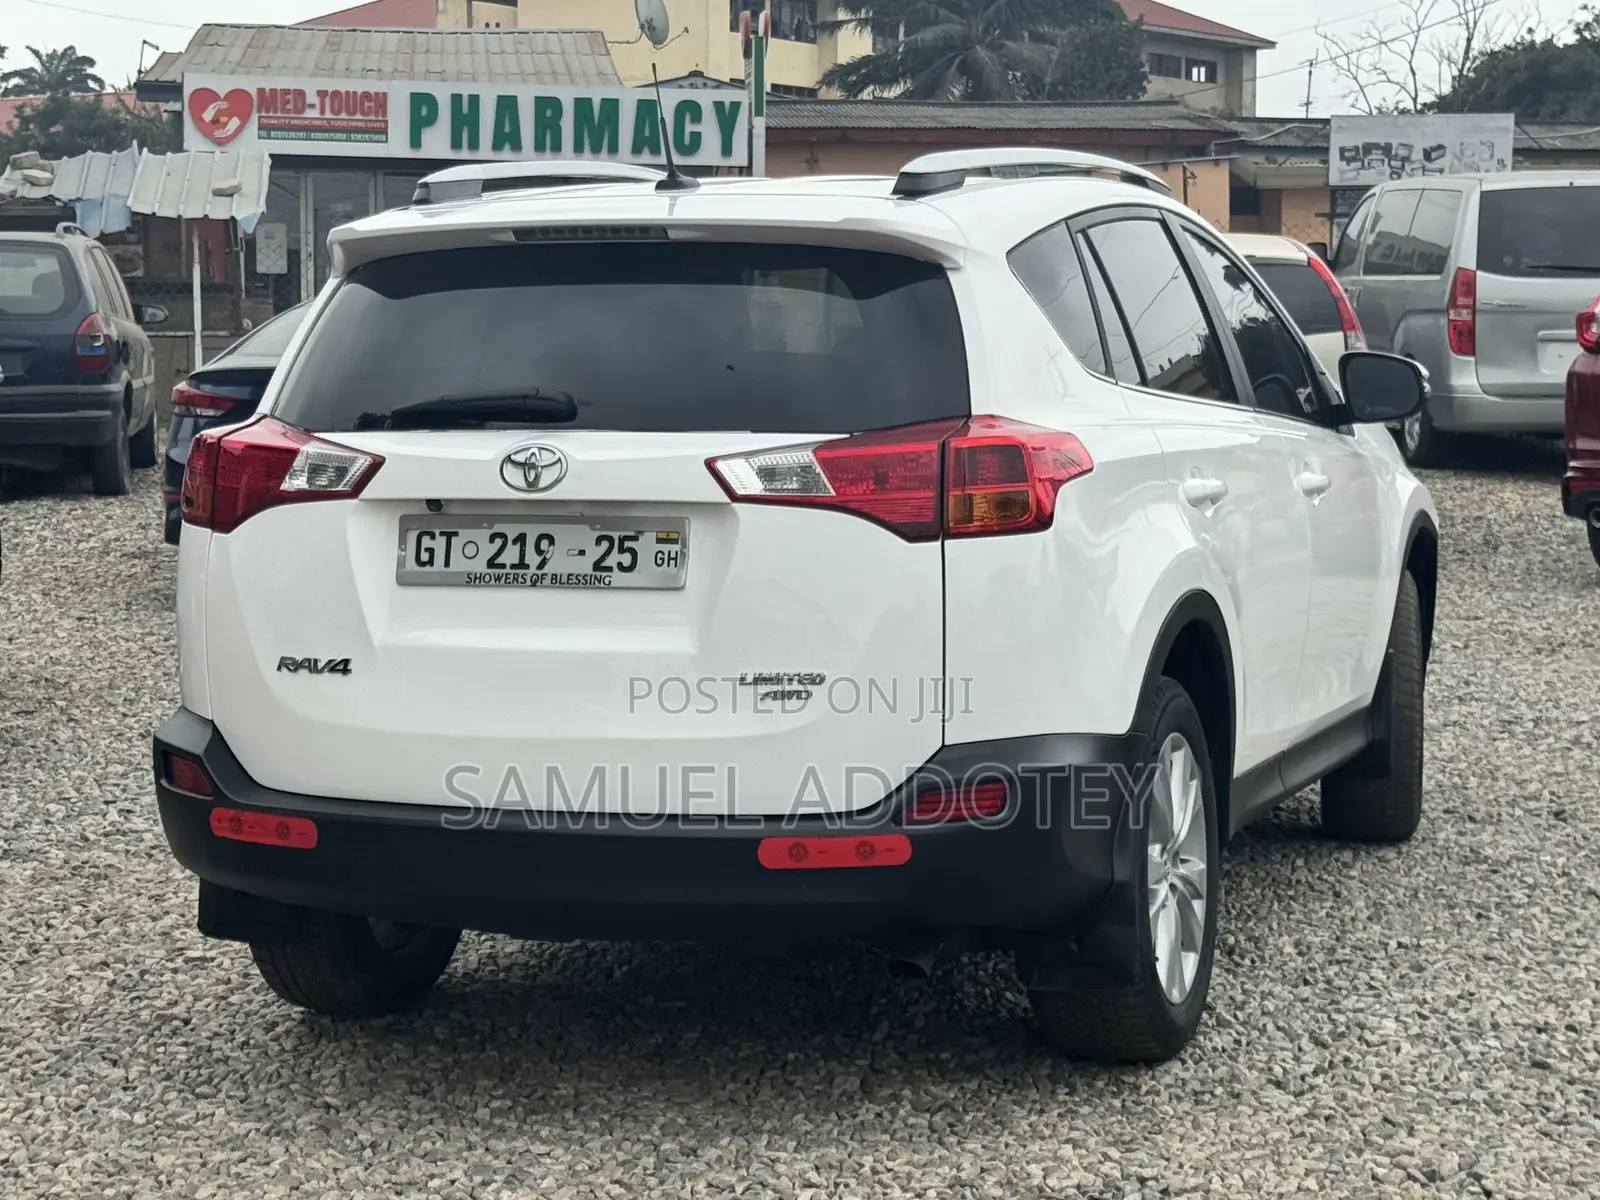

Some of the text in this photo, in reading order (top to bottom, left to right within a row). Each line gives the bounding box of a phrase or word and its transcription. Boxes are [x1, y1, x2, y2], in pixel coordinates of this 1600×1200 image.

[256, 87, 388, 118] MED-TOUCH
[409, 91, 743, 157] PHARMACY
[414, 530, 460, 568] GT
[486, 532, 556, 571] 219
[654, 550, 679, 568] GH
[465, 572, 613, 587] SHOWERS OF BLESSING
[276, 656, 352, 676] RAV4
[739, 672, 826, 686] LIMITED
[759, 689, 813, 701] AWD
